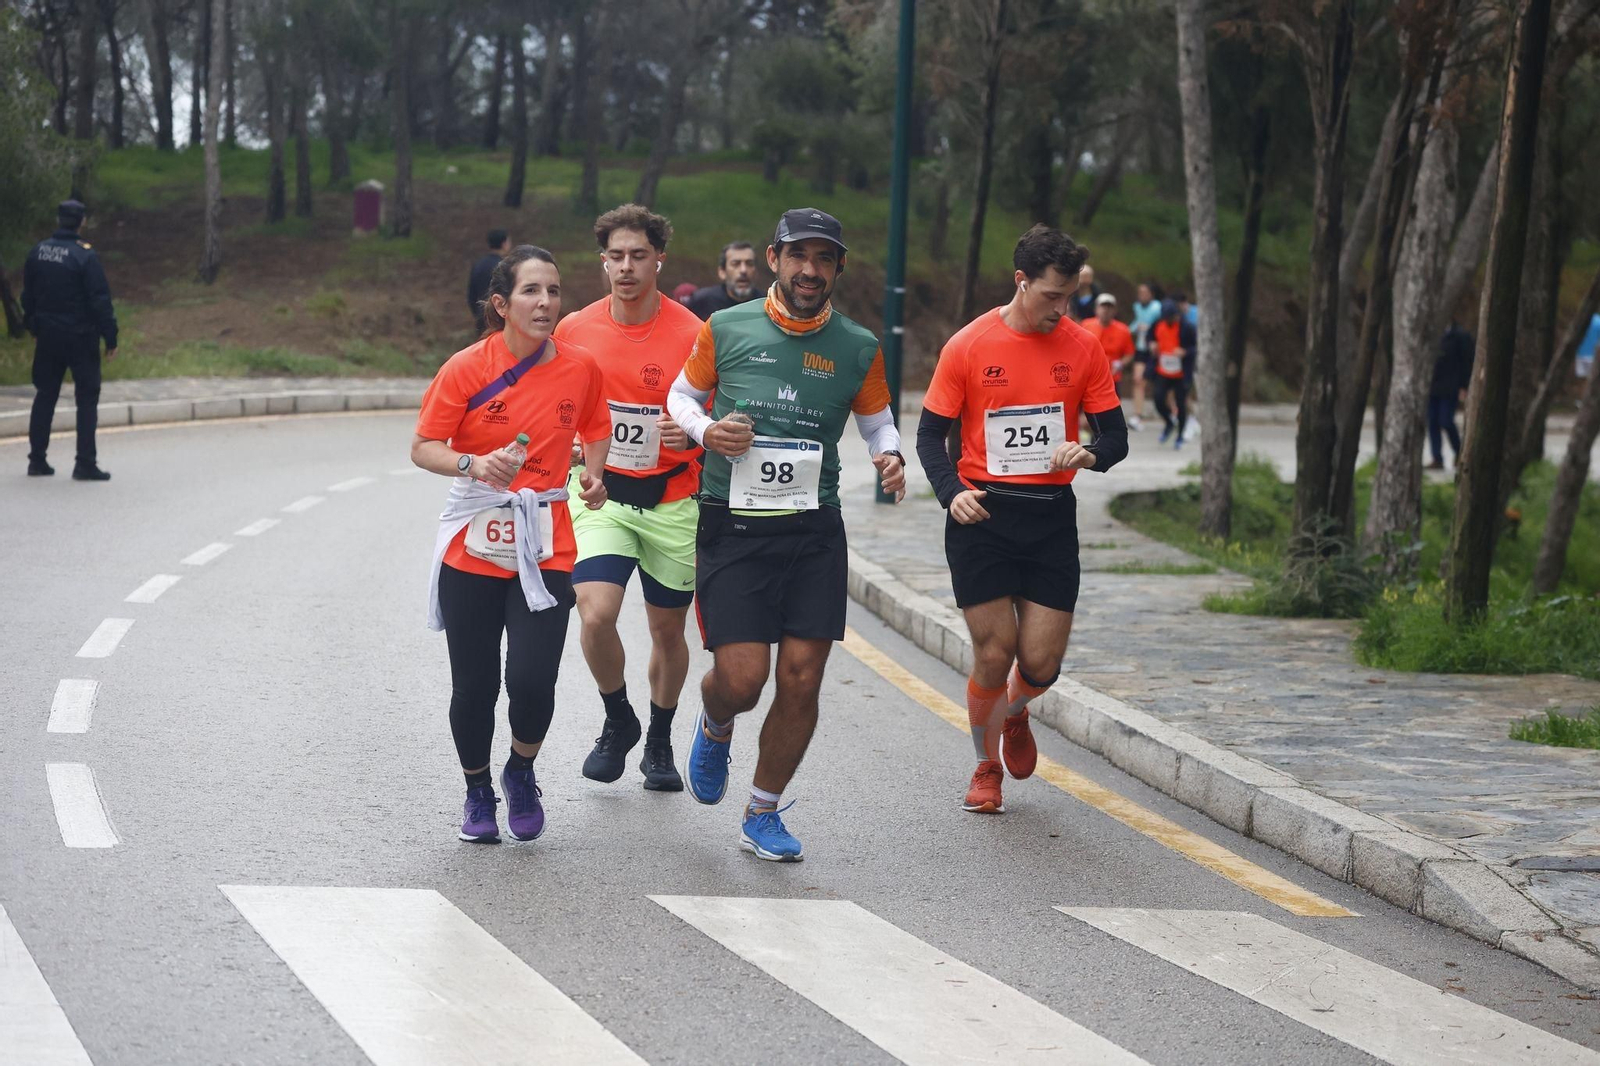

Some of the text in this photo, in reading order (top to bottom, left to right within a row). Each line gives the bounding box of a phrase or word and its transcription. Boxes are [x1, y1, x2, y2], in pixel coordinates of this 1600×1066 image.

[38, 253, 63, 263] LOCAL
[745, 398, 824, 417] CAMINITO DEL REY
[750, 411, 764, 419] ndo
[611, 422, 644, 445] 02
[1004, 425, 1050, 448] 254
[522, 463, 551, 477] Málaga
[760, 461, 794, 484] 98
[486, 519, 515, 544] 63
